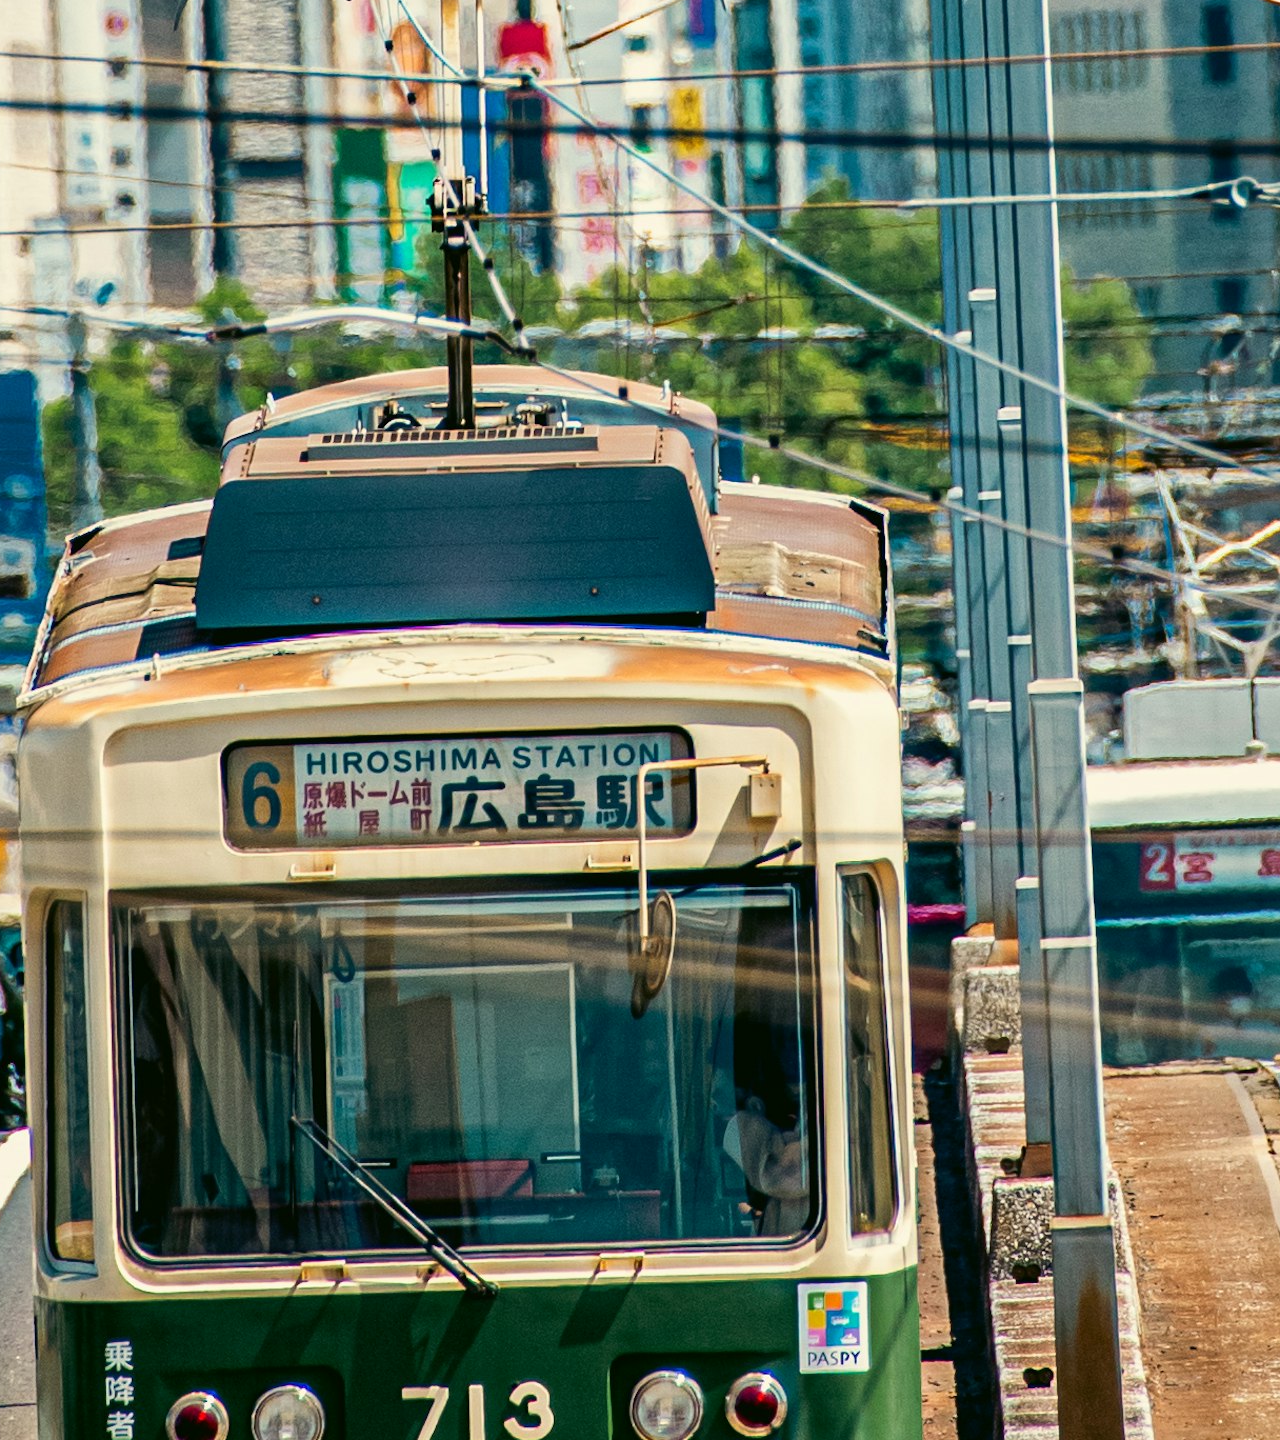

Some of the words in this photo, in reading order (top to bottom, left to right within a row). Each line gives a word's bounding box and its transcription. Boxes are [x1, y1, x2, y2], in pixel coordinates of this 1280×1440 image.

[306, 747, 502, 776] HIROSHIMA
[512, 742, 661, 770] STATION
[241, 761, 282, 834] 6
[302, 778, 433, 810] 原爆ドーム前
[437, 773, 666, 834] 広島駅
[302, 809, 433, 839] 紙屋町
[1144, 843, 1171, 883] 2
[807, 1350, 861, 1367] PASPY
